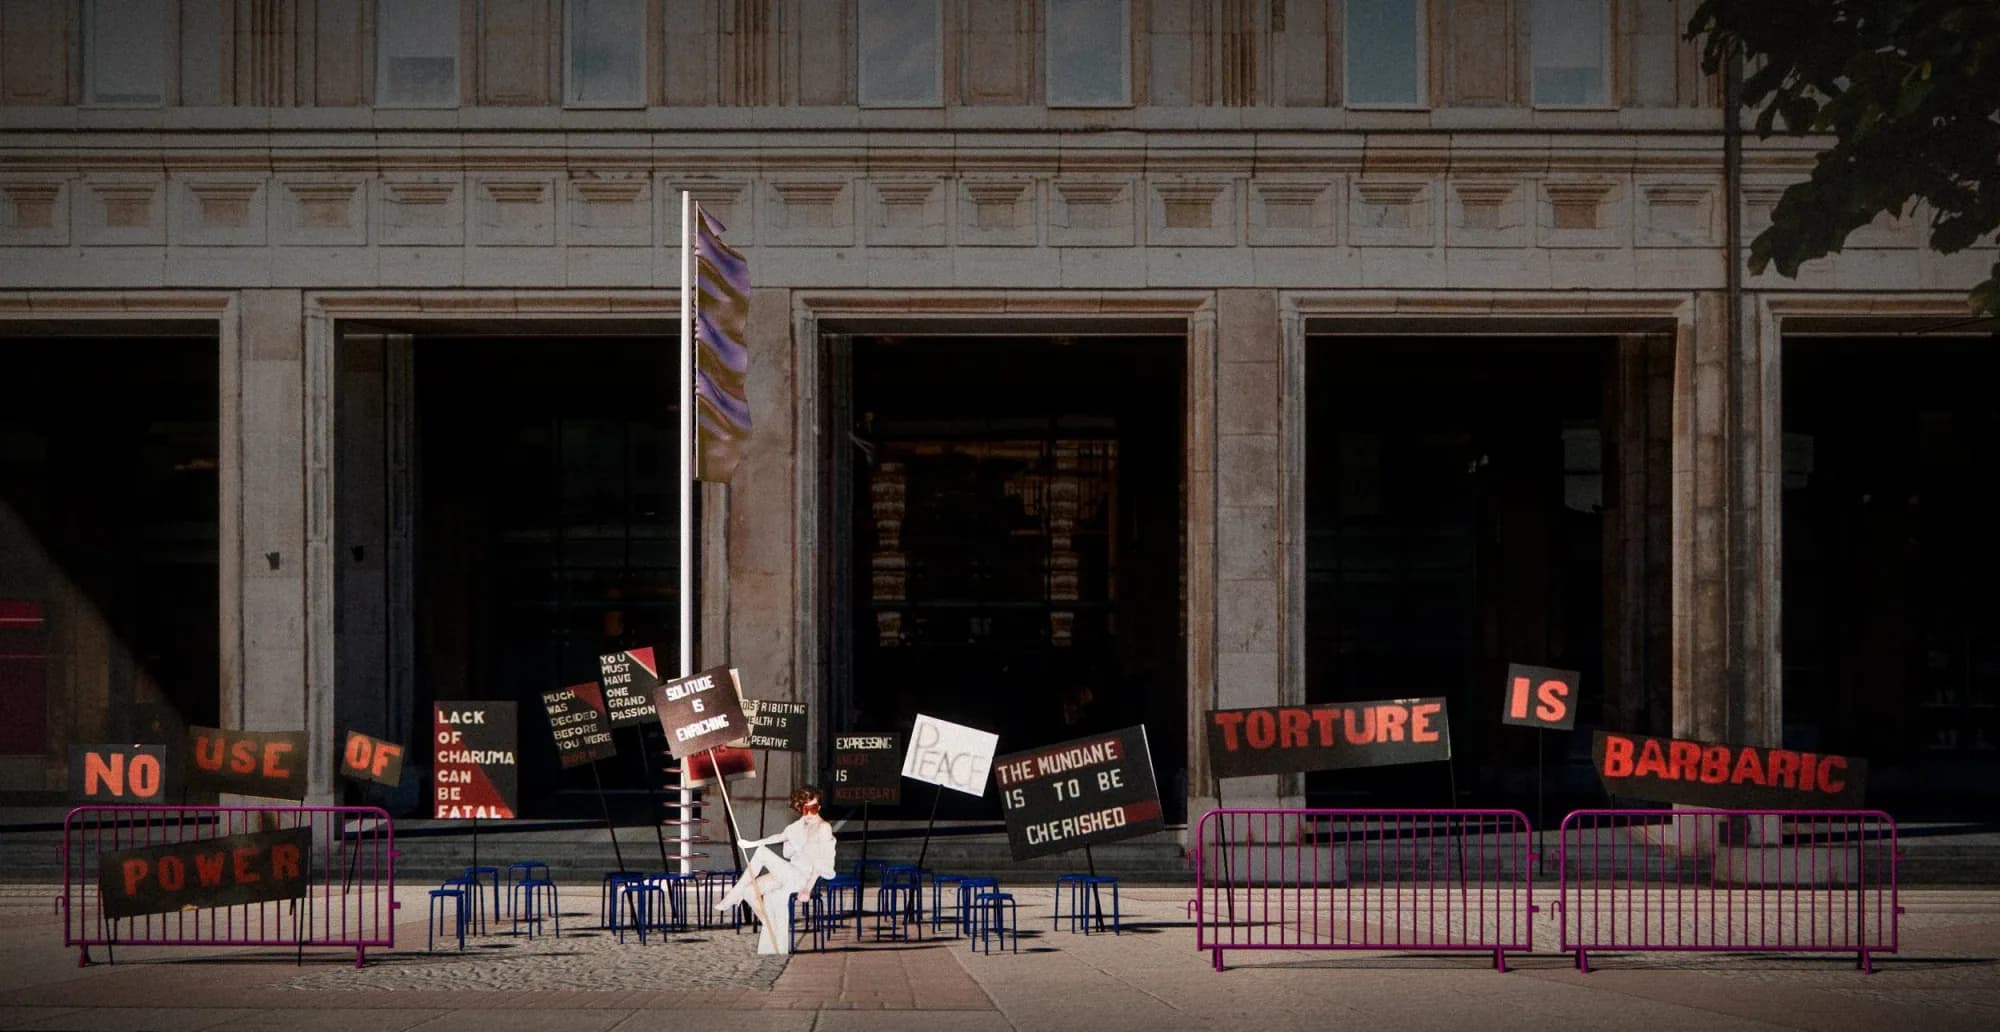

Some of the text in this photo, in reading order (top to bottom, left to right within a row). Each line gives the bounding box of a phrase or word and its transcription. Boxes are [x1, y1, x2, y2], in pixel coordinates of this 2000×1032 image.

[600, 653, 626, 665] YOU
[601, 663, 631, 675] MUST
[603, 673, 632, 686] HAVE
[606, 687, 629, 698] ONE
[665, 675, 715, 702] SOLITUDE
[543, 690, 576, 705] MUCH
[608, 695, 646, 709] GRAND
[1509, 676, 1569, 722] IS
[546, 703, 569, 716] WAS
[610, 705, 656, 721] PASSION
[692, 698, 705, 713] IS
[438, 710, 486, 725] LACK
[550, 710, 598, 727] DECIDED
[776, 717, 788, 728] IS
[552, 723, 599, 741] BEFORE
[675, 714, 730, 742] ENRICHING
[1213, 703, 1442, 753] TORTURE
[438, 731, 462, 745] OF
[556, 732, 613, 750] YOU WERE
[835, 736, 893, 750] EXPRESSING
[195, 736, 294, 779] USE
[344, 735, 400, 777] OF
[438, 750, 516, 765] CHARISMA
[911, 722, 987, 793] PEACE
[997, 741, 1119, 784] THE MUNDANE
[1603, 735, 1849, 794] BARBARIC
[84, 752, 161, 798] NO
[438, 769, 472, 784] CAN
[835, 769, 849, 782] IS
[438, 787, 462, 801] BE
[1005, 768, 1124, 810] IS TO BE
[437, 805, 503, 819] FATAL
[1026, 806, 1127, 845] CHERISHED
[121, 843, 301, 897] POWER
